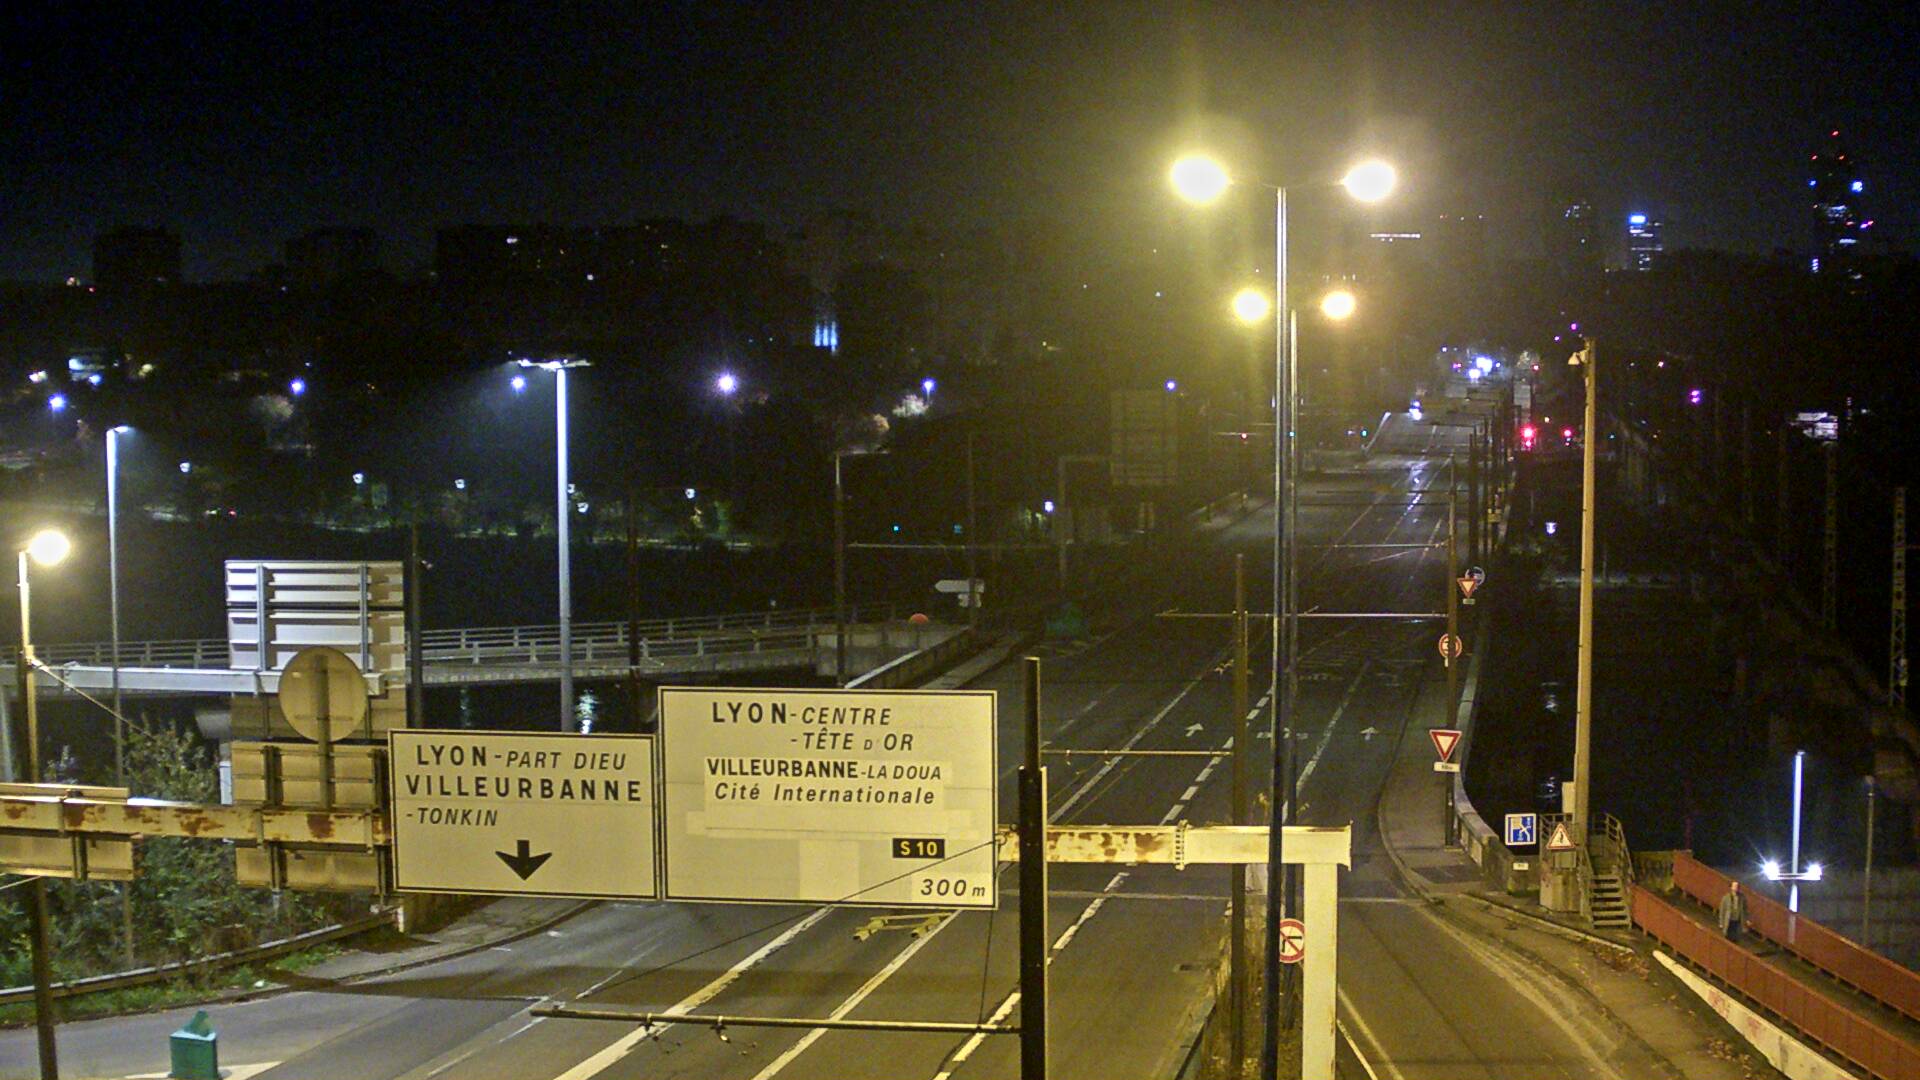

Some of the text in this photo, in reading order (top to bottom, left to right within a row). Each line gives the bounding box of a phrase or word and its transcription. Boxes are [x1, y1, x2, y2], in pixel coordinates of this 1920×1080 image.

[712, 701, 892, 726] LYON-CENTRE
[790, 727, 854, 750] -TÊTE
[573, 752, 626, 771] DIEU
[706, 758, 942, 780] VILLEURBANNE-LA DOUA
[405, 774, 642, 802] VILLEURBANNE
[714, 782, 935, 805] Cité Internationale
[406, 807, 498, 827] -TONKIN
[900, 841, 938, 857] S 10
[920, 878, 986, 897] 300 m
